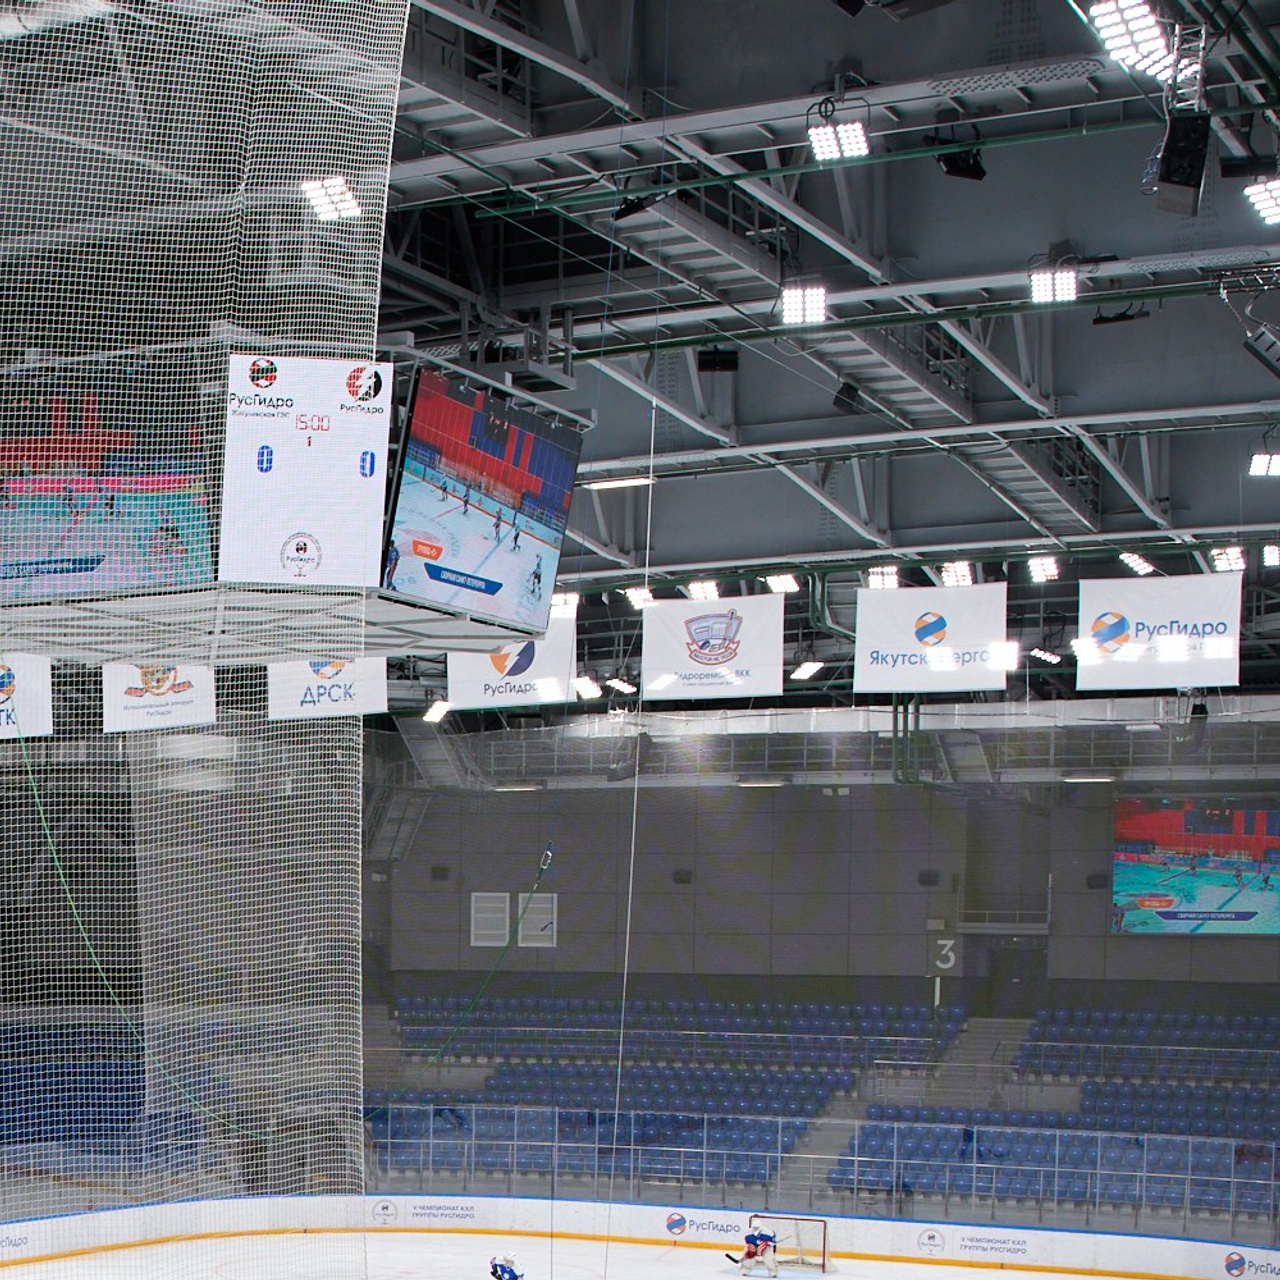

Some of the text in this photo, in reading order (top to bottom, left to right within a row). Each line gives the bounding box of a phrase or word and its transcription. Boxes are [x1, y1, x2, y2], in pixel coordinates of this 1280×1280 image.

[228, 392, 294, 410] РусГидро
[340, 403, 384, 414] РусГидро
[295, 414, 330, 431] 15:00
[257, 445, 273, 473] 0
[359, 450, 375, 478] 0
[1135, 620, 1228, 641] РусГидро
[870, 650, 989, 668] Якутскерго
[300, 682, 355, 707] ДРСК
[936, 939, 955, 969] 3
[689, 1220, 741, 1233] РусГидро
[960, 1244, 1027, 1254] ГРУППЫ РУСГИДРО
[966, 1237, 1011, 1245] ЧЕМПИОНАТ
